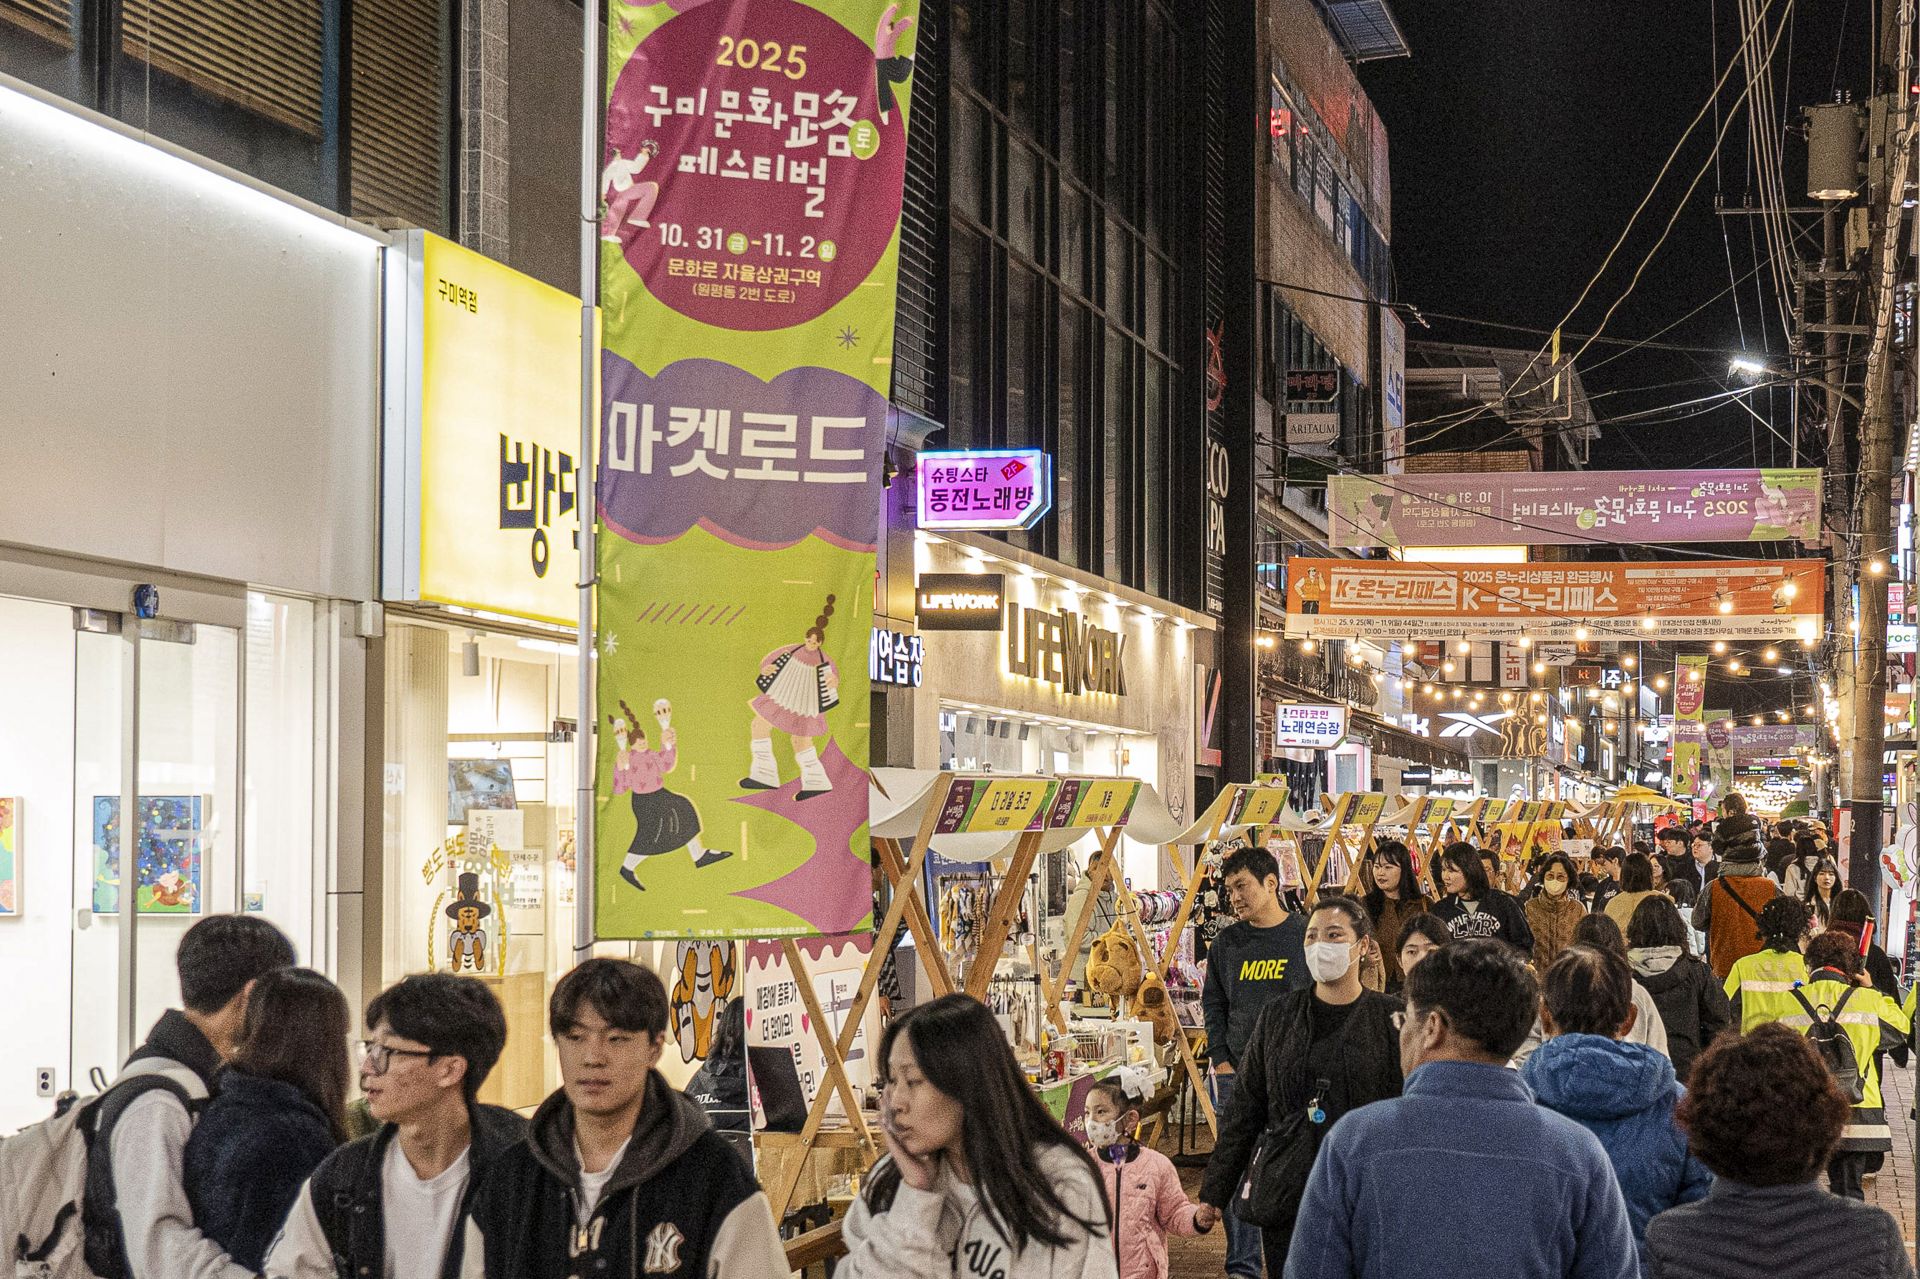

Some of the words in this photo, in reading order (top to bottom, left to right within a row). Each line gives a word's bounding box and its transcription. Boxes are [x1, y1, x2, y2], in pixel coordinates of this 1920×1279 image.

[716, 36, 807, 80] 2025
[644, 85, 708, 127] 구미
[678, 146, 828, 218] 페스티벌
[658, 223, 688, 248] 10.
[668, 258, 717, 279] 문화로
[723, 264, 822, 288] 자율상권구역
[439, 279, 478, 314] 구미역점
[692, 284, 736, 299] (원평동
[739, 287, 760, 301] 2번
[763, 289, 796, 303] 도로)
[607, 400, 868, 483] 마켓로드
[1291, 424, 1335, 434] ARITAUM
[931, 467, 988, 483] 슈팅스타
[930, 486, 1034, 512] 동전노래방
[1335, 579, 1454, 600] K-온누리패스
[1463, 571, 1493, 583] 2025
[1495, 570, 1565, 584] 온누리상품권
[1567, 570, 1613, 584] 환급행사
[922, 594, 999, 611] LIFEWORK
[1462, 586, 1619, 613] K-온누리패스
[1009, 602, 1128, 697] LIFEWORK
[1579, 641, 1590, 652] kt
[1579, 669, 1590, 679] kt
[1289, 709, 1329, 720] 스타코인
[1281, 721, 1340, 735] 노래연습장
[1239, 959, 1288, 981] MORE
[757, 984, 777, 1011] 매장에
[762, 1018, 770, 1041] 더
[771, 1013, 794, 1040] 많아요!
